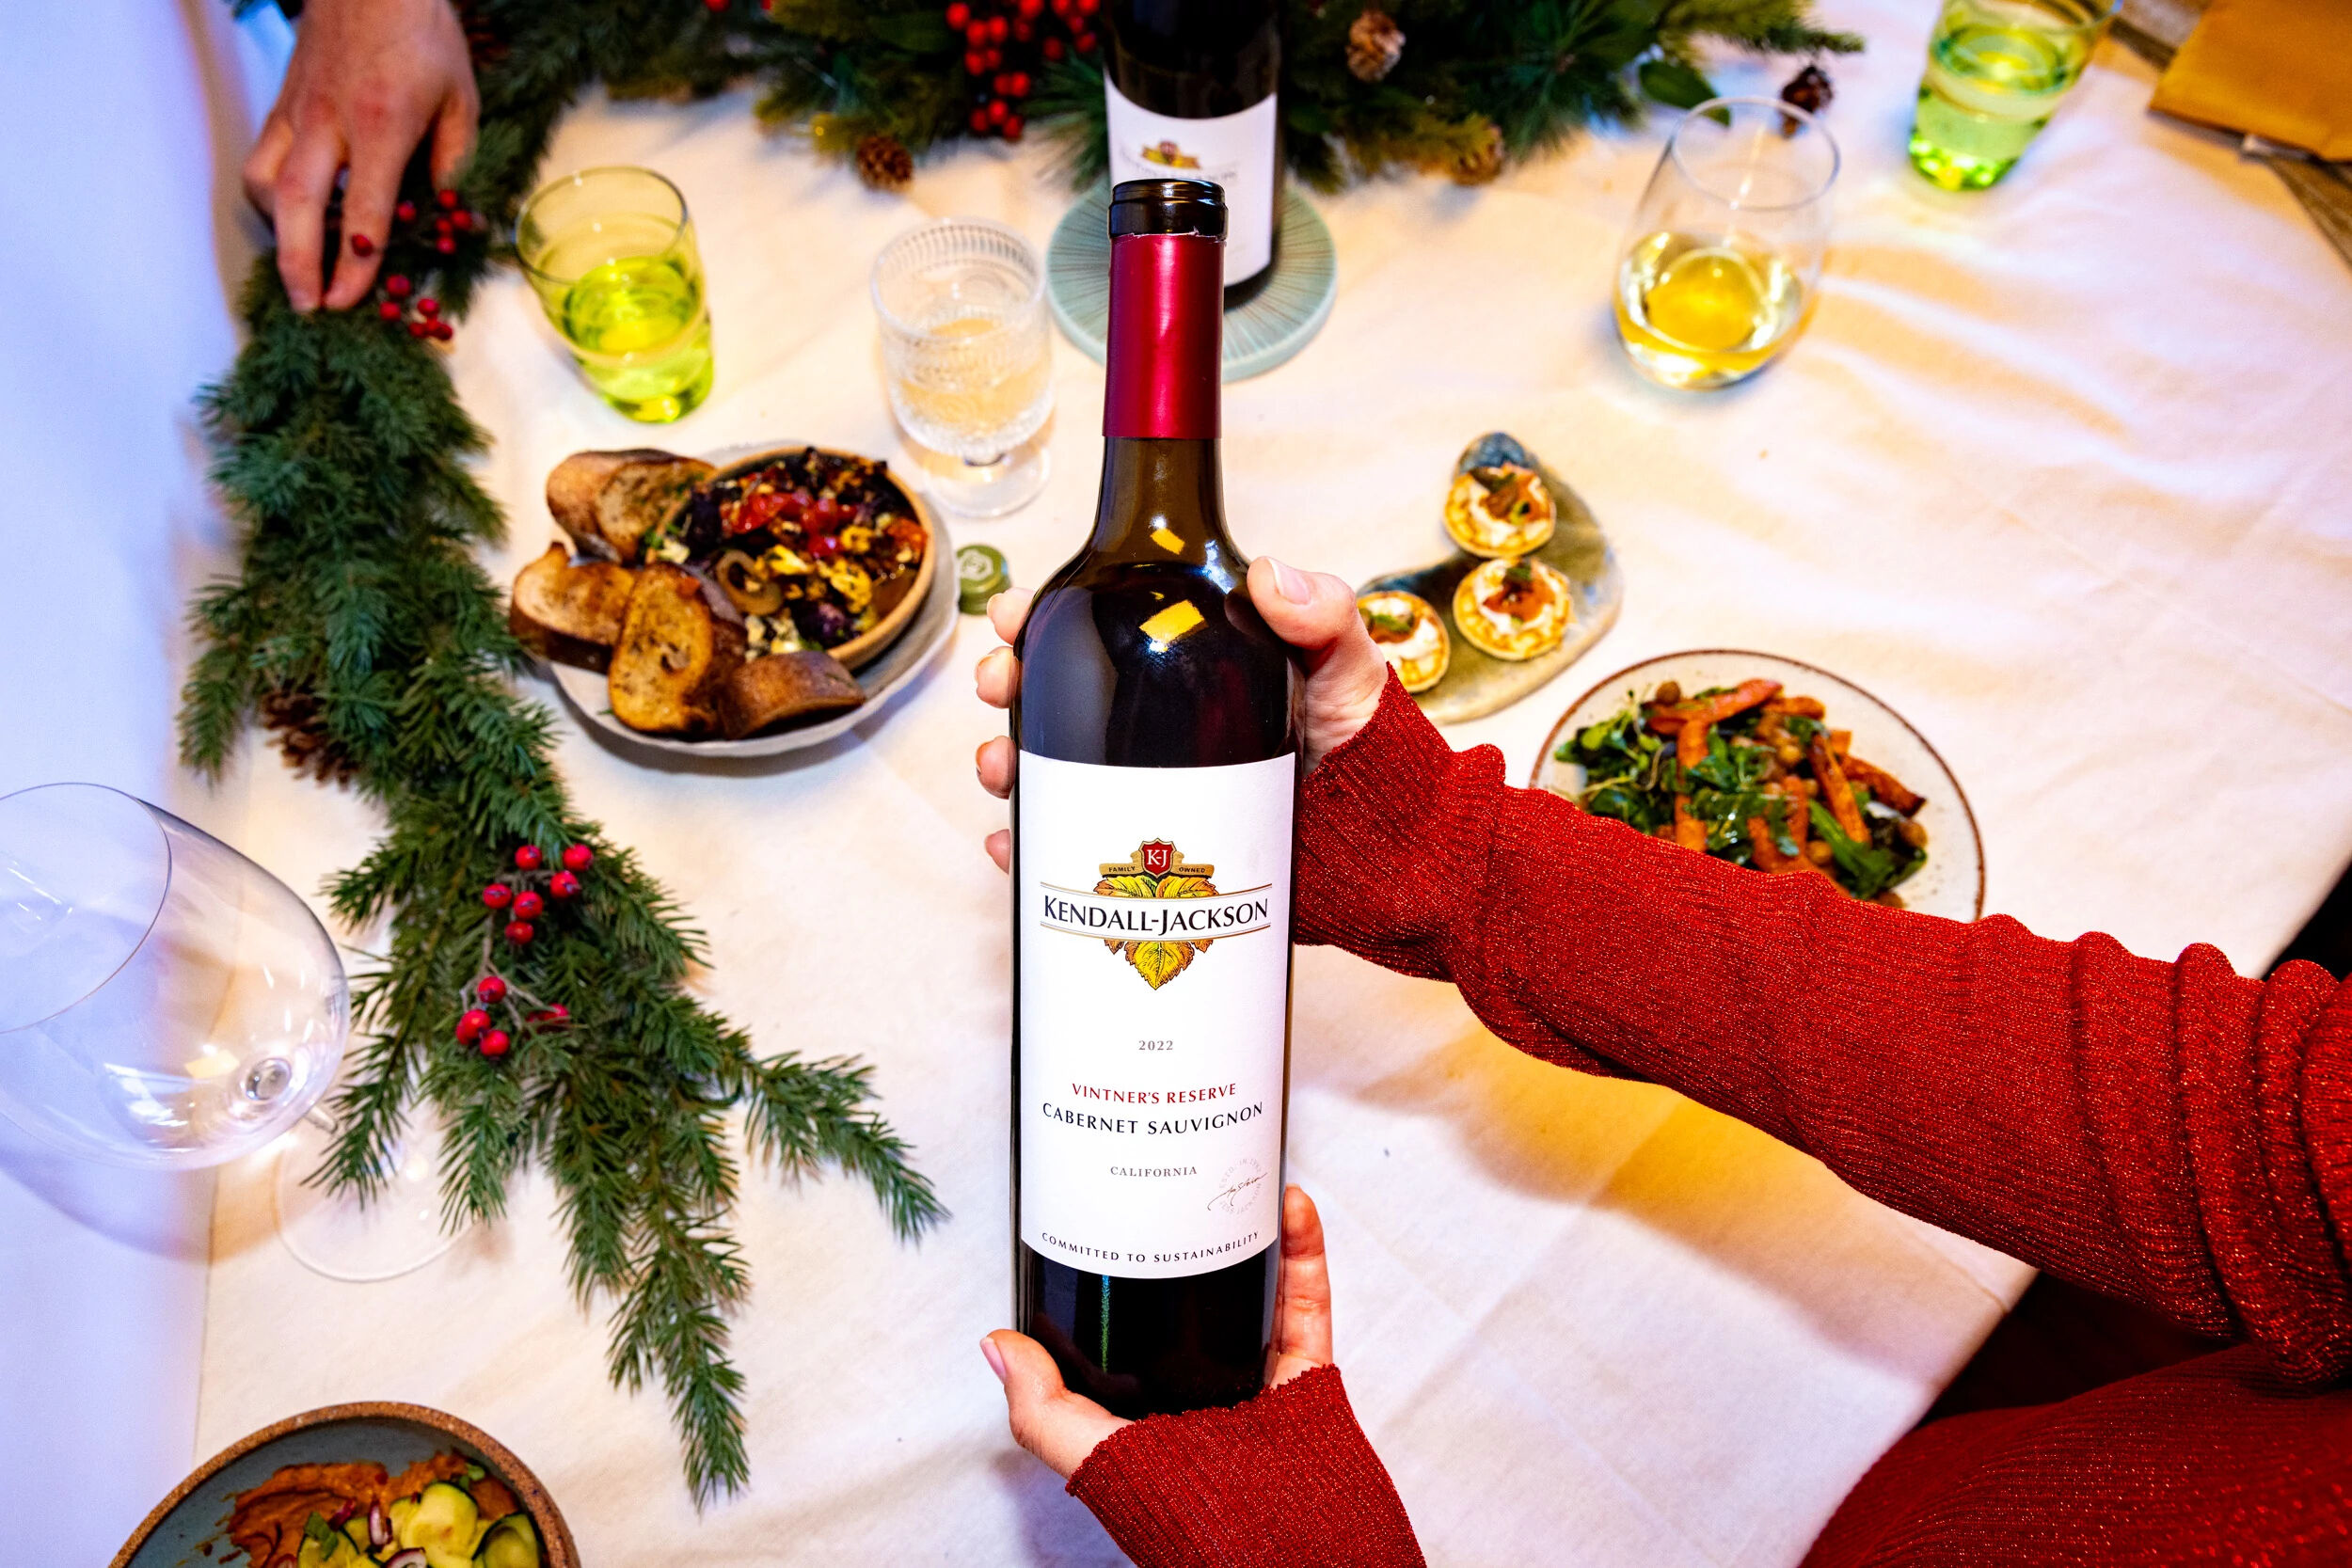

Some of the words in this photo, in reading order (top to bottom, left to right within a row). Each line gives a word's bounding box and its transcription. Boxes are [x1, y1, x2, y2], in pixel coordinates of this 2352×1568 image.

[1146, 849, 1168, 867] K-J
[1044, 895, 1268, 936] KENDALL-JACKSON
[1138, 1039, 1174, 1051] 2022
[1072, 1083, 1160, 1104] VINTNER'S
[1167, 1083, 1236, 1103] RESERVE
[1042, 1102, 1138, 1134] CABERNET
[1147, 1101, 1263, 1135] SAUVIGNON
[1110, 1165, 1198, 1178] CALIFORNIA
[1041, 1232, 1120, 1260] COMMITTED
[1127, 1253, 1146, 1263] TO
[1153, 1231, 1260, 1263] SUSTAINABILITY
